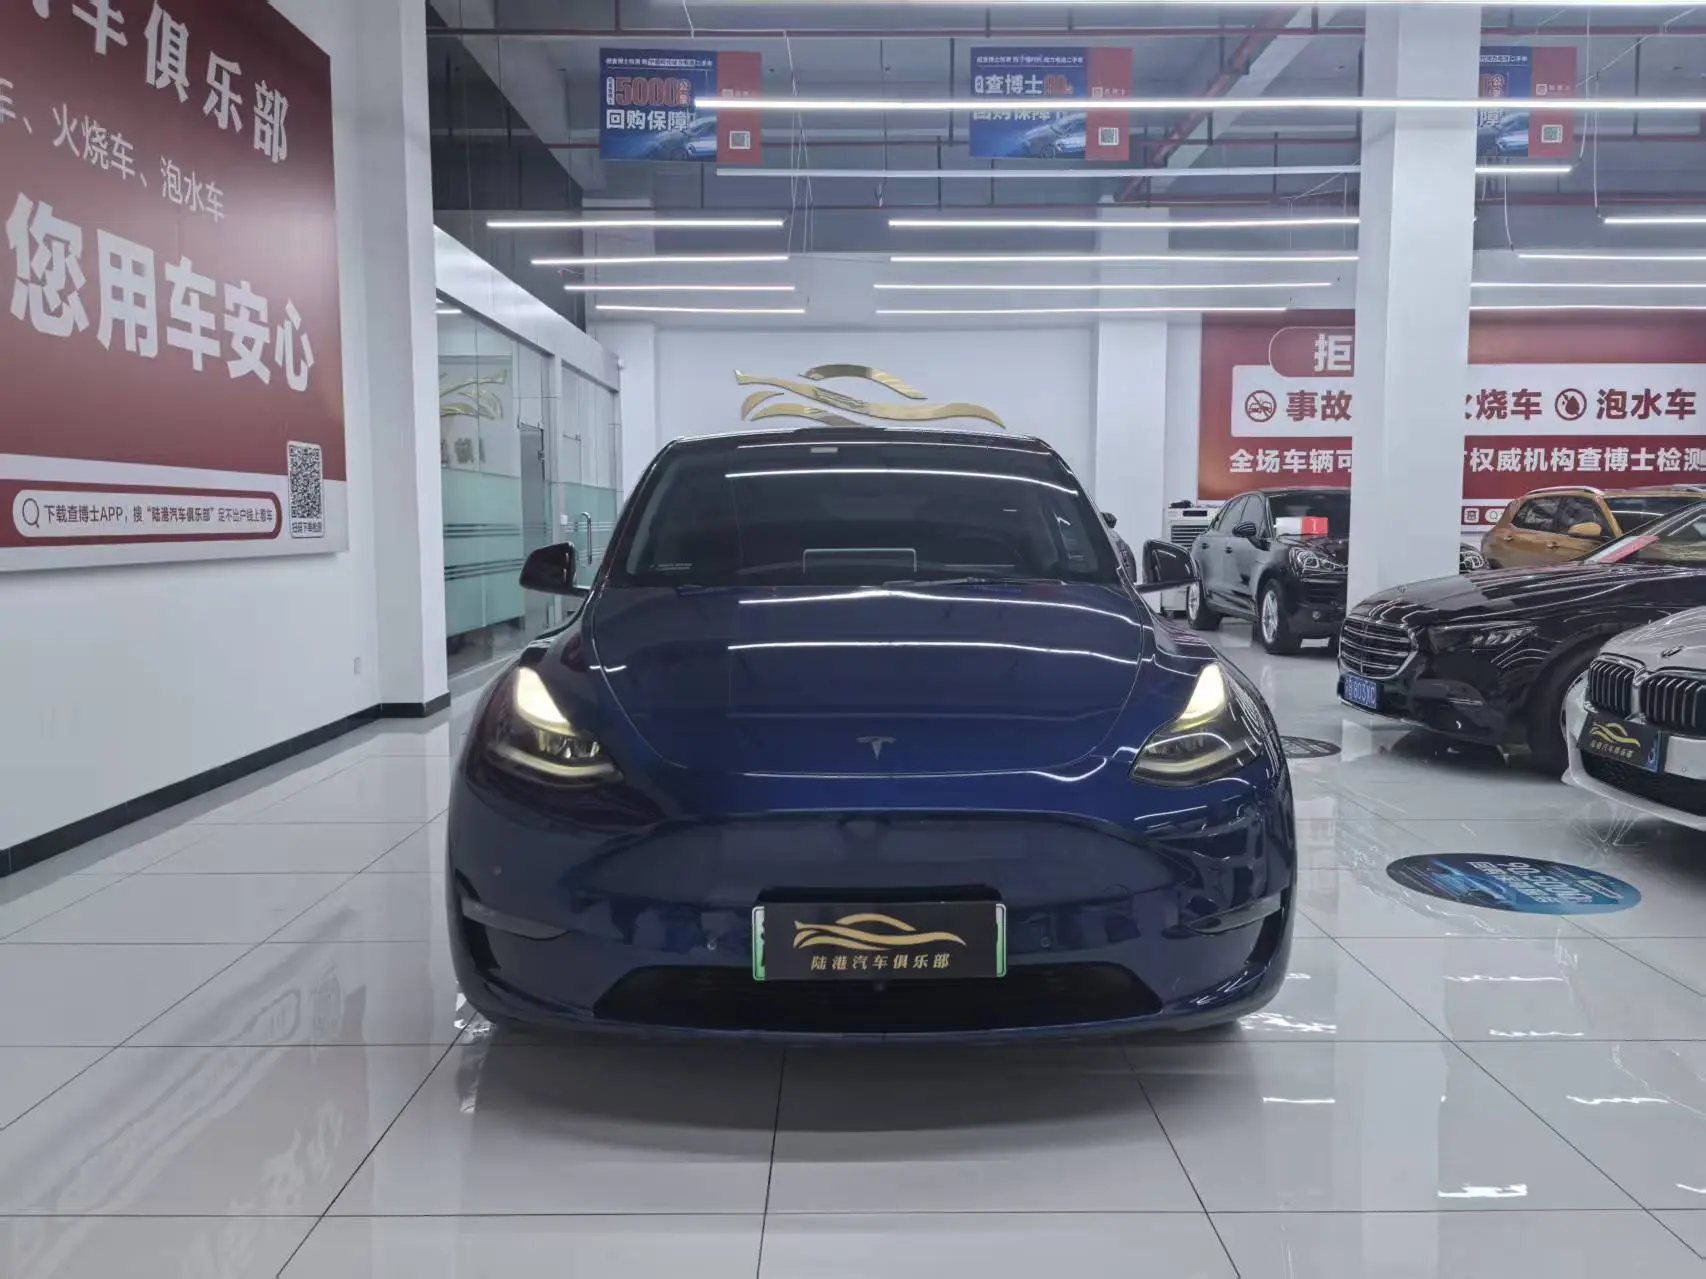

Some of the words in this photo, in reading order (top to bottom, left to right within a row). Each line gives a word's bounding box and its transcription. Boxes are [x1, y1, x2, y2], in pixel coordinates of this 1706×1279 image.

[32, 0, 289, 163] 车俱乐部
[606, 109, 688, 131] 回购保障
[5, 192, 314, 392] 您用车安心
[1313, 333, 1352, 372] 拒
[1285, 389, 1353, 422] 事故
[1596, 388, 1697, 421] 泡水车
[1229, 447, 1352, 474] 全场车辆可
[1463, 447, 1706, 473] 权威机构查博士检测
[811, 953, 950, 970] 陆港汽车俱乐部
